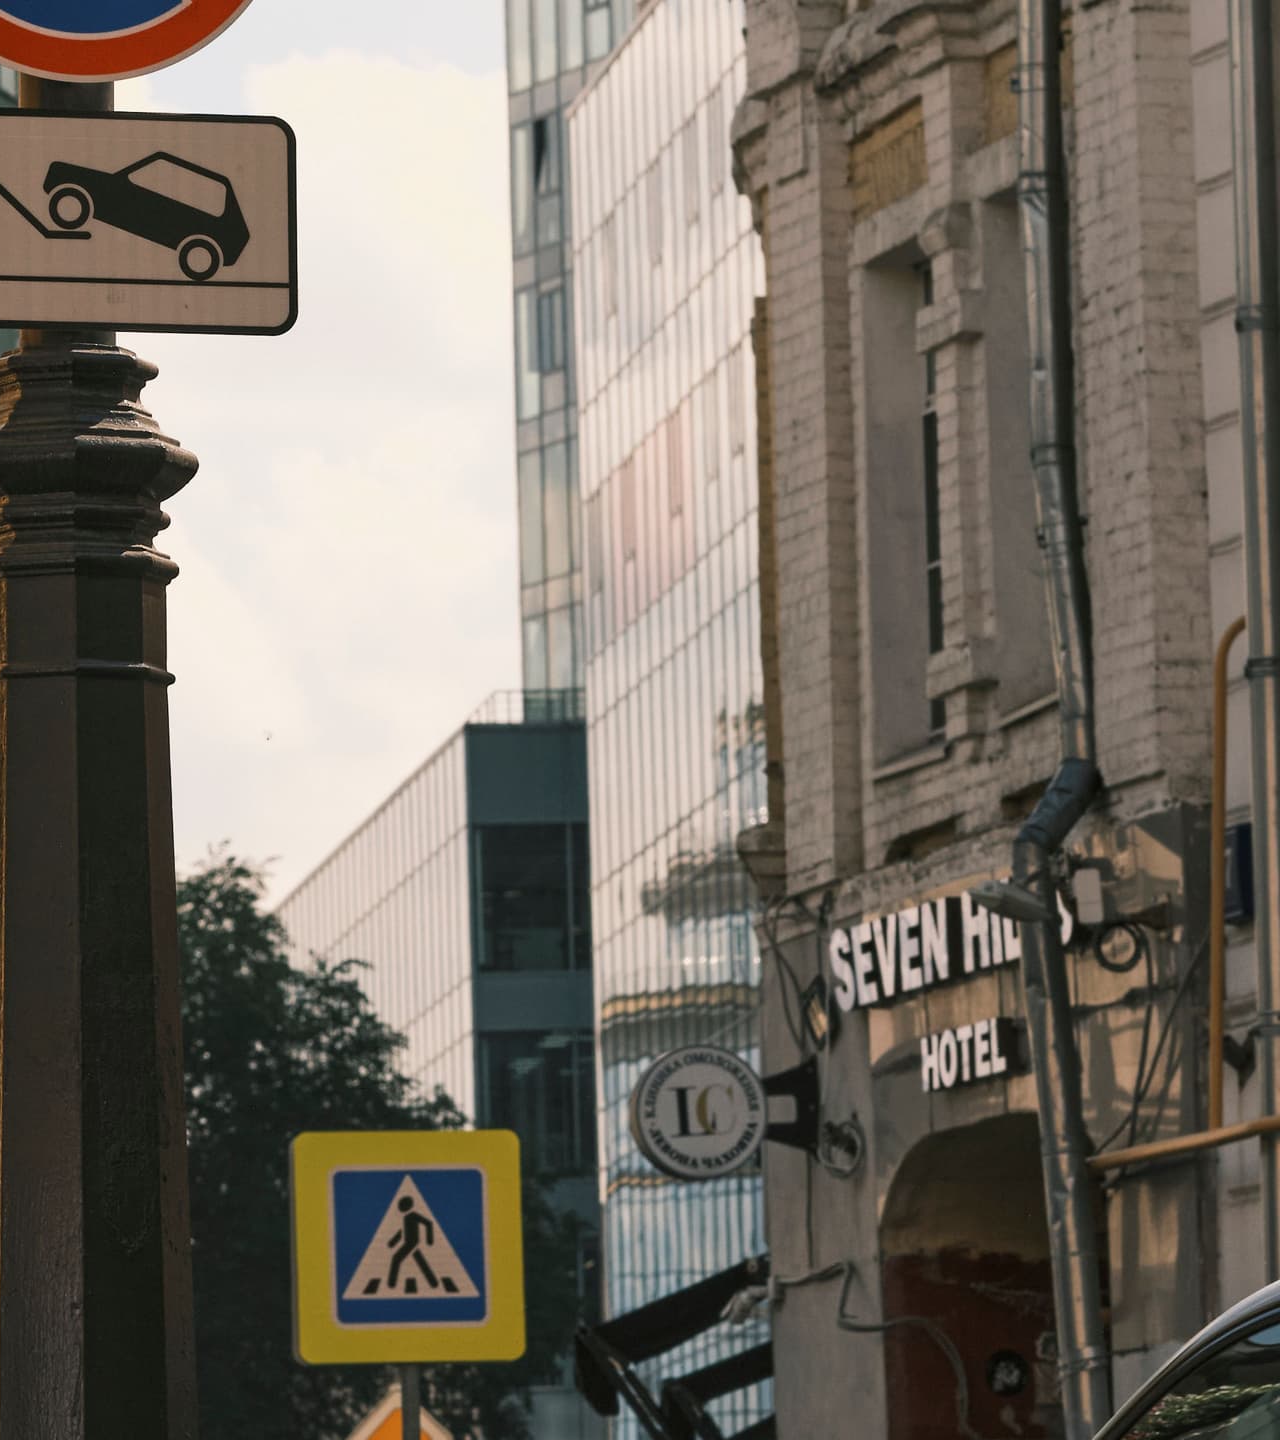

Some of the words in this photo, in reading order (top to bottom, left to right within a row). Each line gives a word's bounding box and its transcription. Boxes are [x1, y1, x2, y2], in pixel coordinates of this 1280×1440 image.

[830, 897, 949, 1012] SEVEN
[961, 877, 1073, 974] HIL
[921, 1018, 1007, 1093] HOTEL
